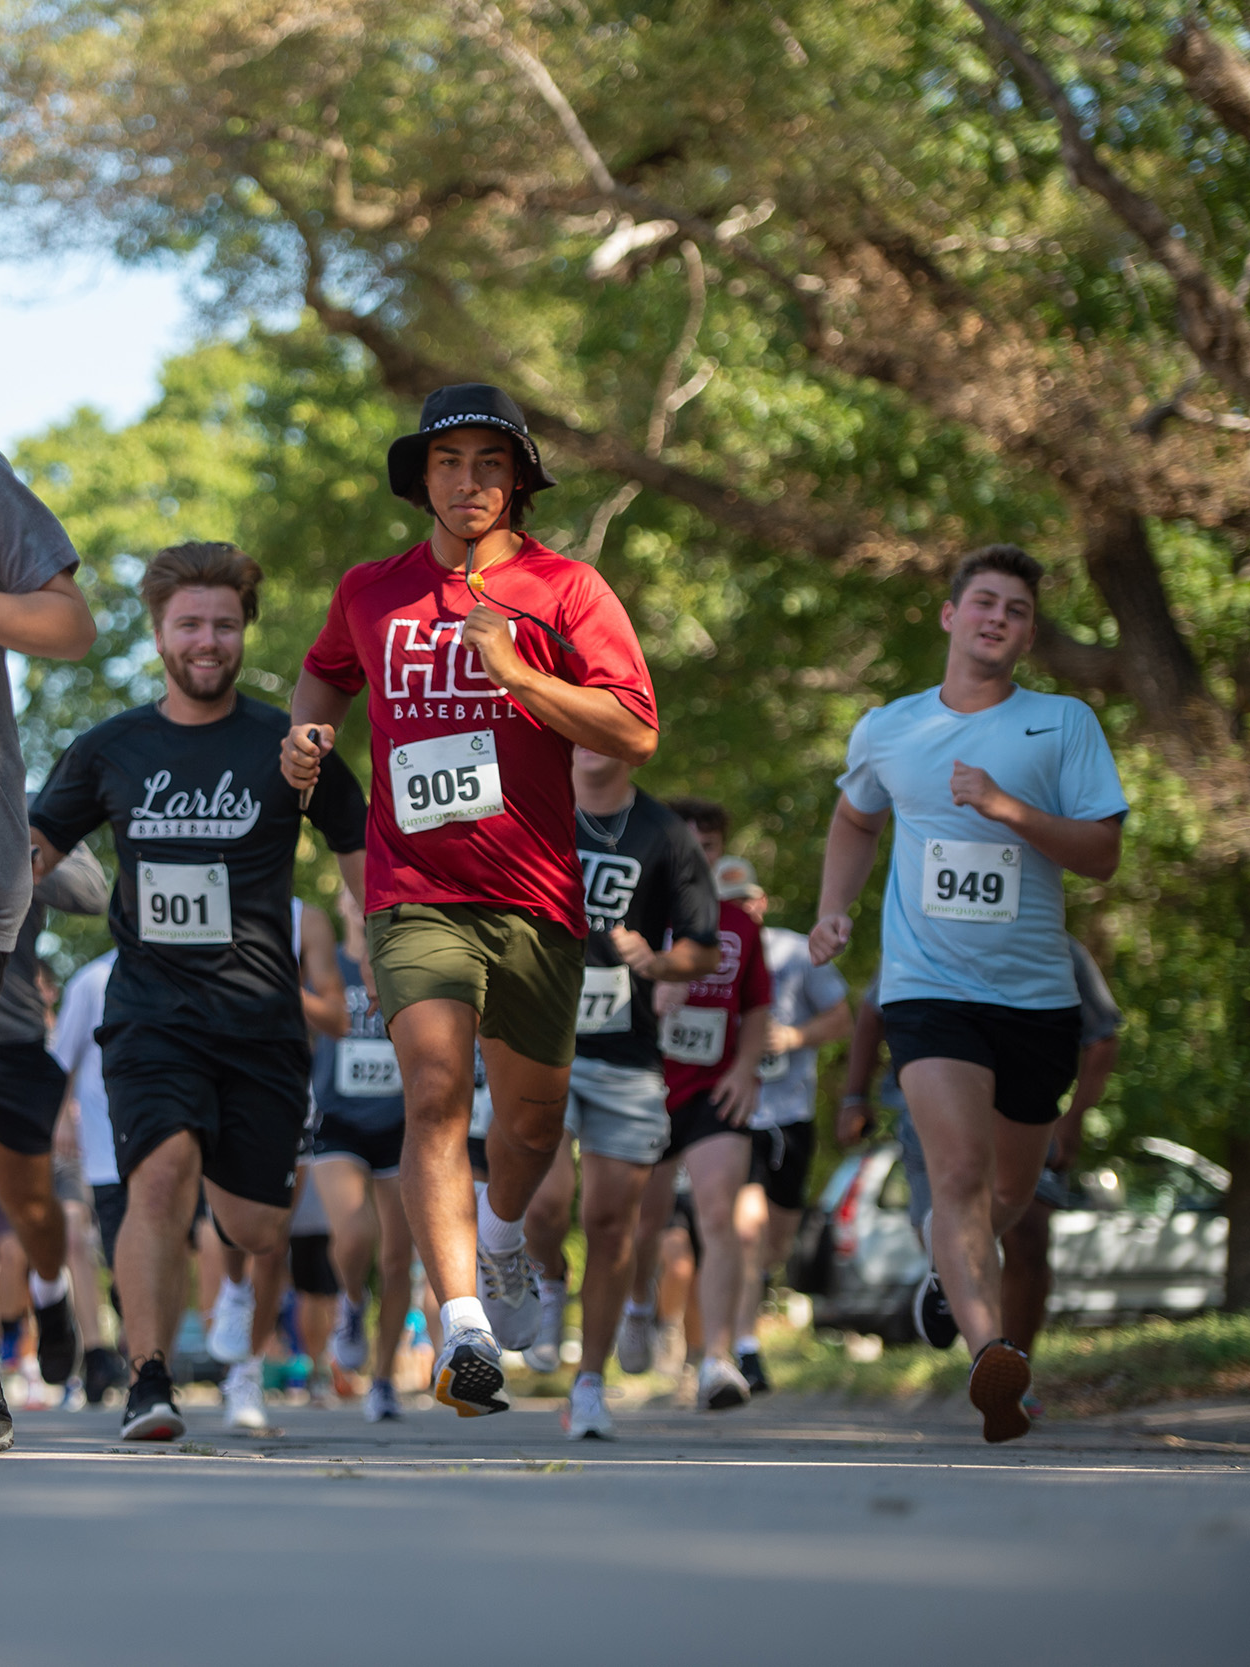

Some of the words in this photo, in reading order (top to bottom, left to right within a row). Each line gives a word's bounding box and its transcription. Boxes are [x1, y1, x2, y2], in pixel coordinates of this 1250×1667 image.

[394, 702, 518, 719] BASEBALL
[131, 769, 254, 820] Larks
[408, 765, 481, 810] 905
[139, 823, 237, 836] BASEBALL
[937, 869, 1005, 905] 949
[151, 893, 208, 926] 901
[577, 993, 618, 1018] 77
